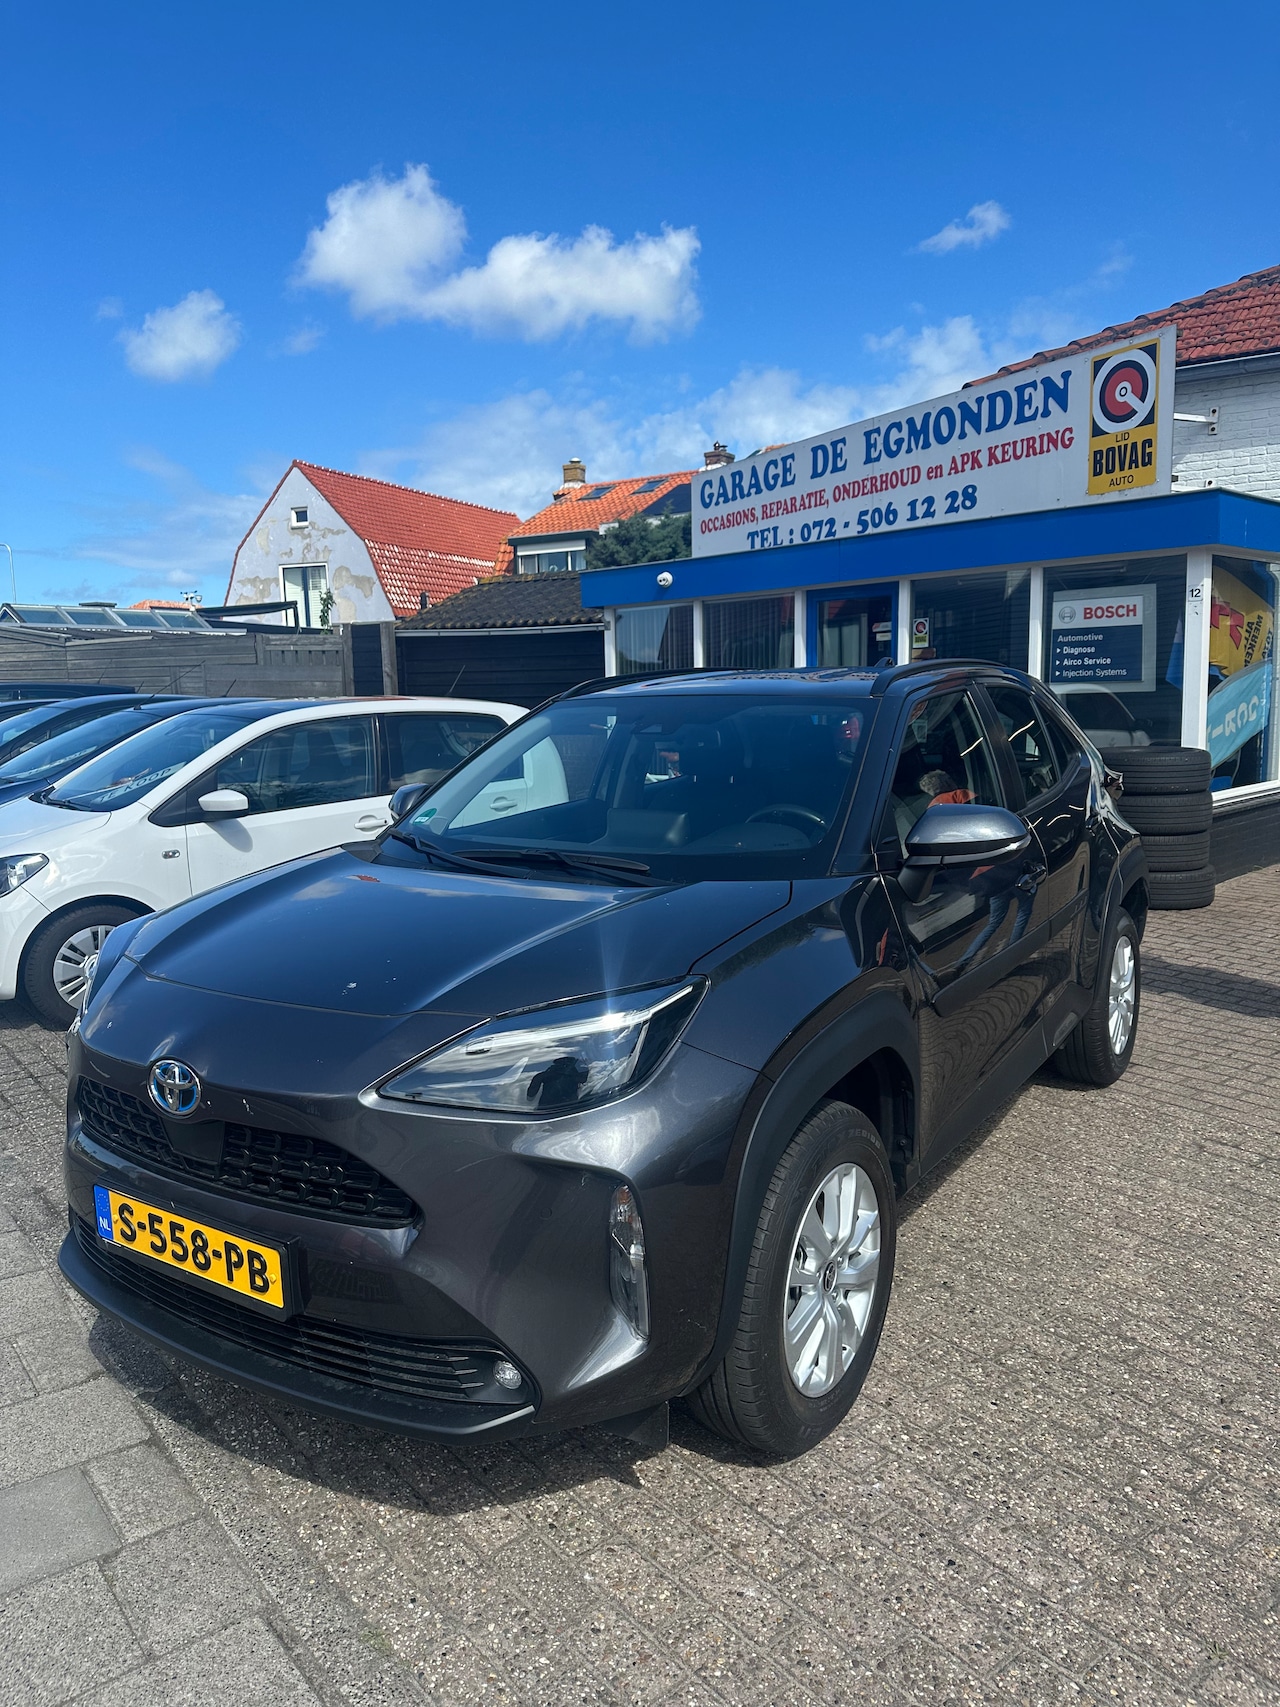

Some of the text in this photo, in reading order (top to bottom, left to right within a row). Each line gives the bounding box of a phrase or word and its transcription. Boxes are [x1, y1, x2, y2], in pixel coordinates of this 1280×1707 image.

[700, 370, 1072, 509] GARAGE DE EGMONDEN
[1115, 432, 1130, 442] LID
[1092, 438, 1153, 477] BOVAG
[700, 427, 1074, 535] OCCASIONS, REPARATIE, ONDERHOUD en APK KEURING
[1109, 474, 1134, 487] AUTO
[800, 517, 837, 542] 072
[857, 501, 898, 535] 506
[906, 495, 936, 522] 12
[944, 484, 978, 515] 28
[1189, 588, 1201, 598] 12
[1083, 604, 1137, 620] BOSCH
[1057, 633, 1104, 642] Automotive
[1063, 646, 1096, 655] Diagnose
[1063, 656, 1112, 666] Airco Service
[1063, 668, 1127, 678] Injection Systems
[124, 768, 171, 792] KOOP
[99, 1216, 111, 1231] NL
[117, 1202, 270, 1294] S-558-PB
